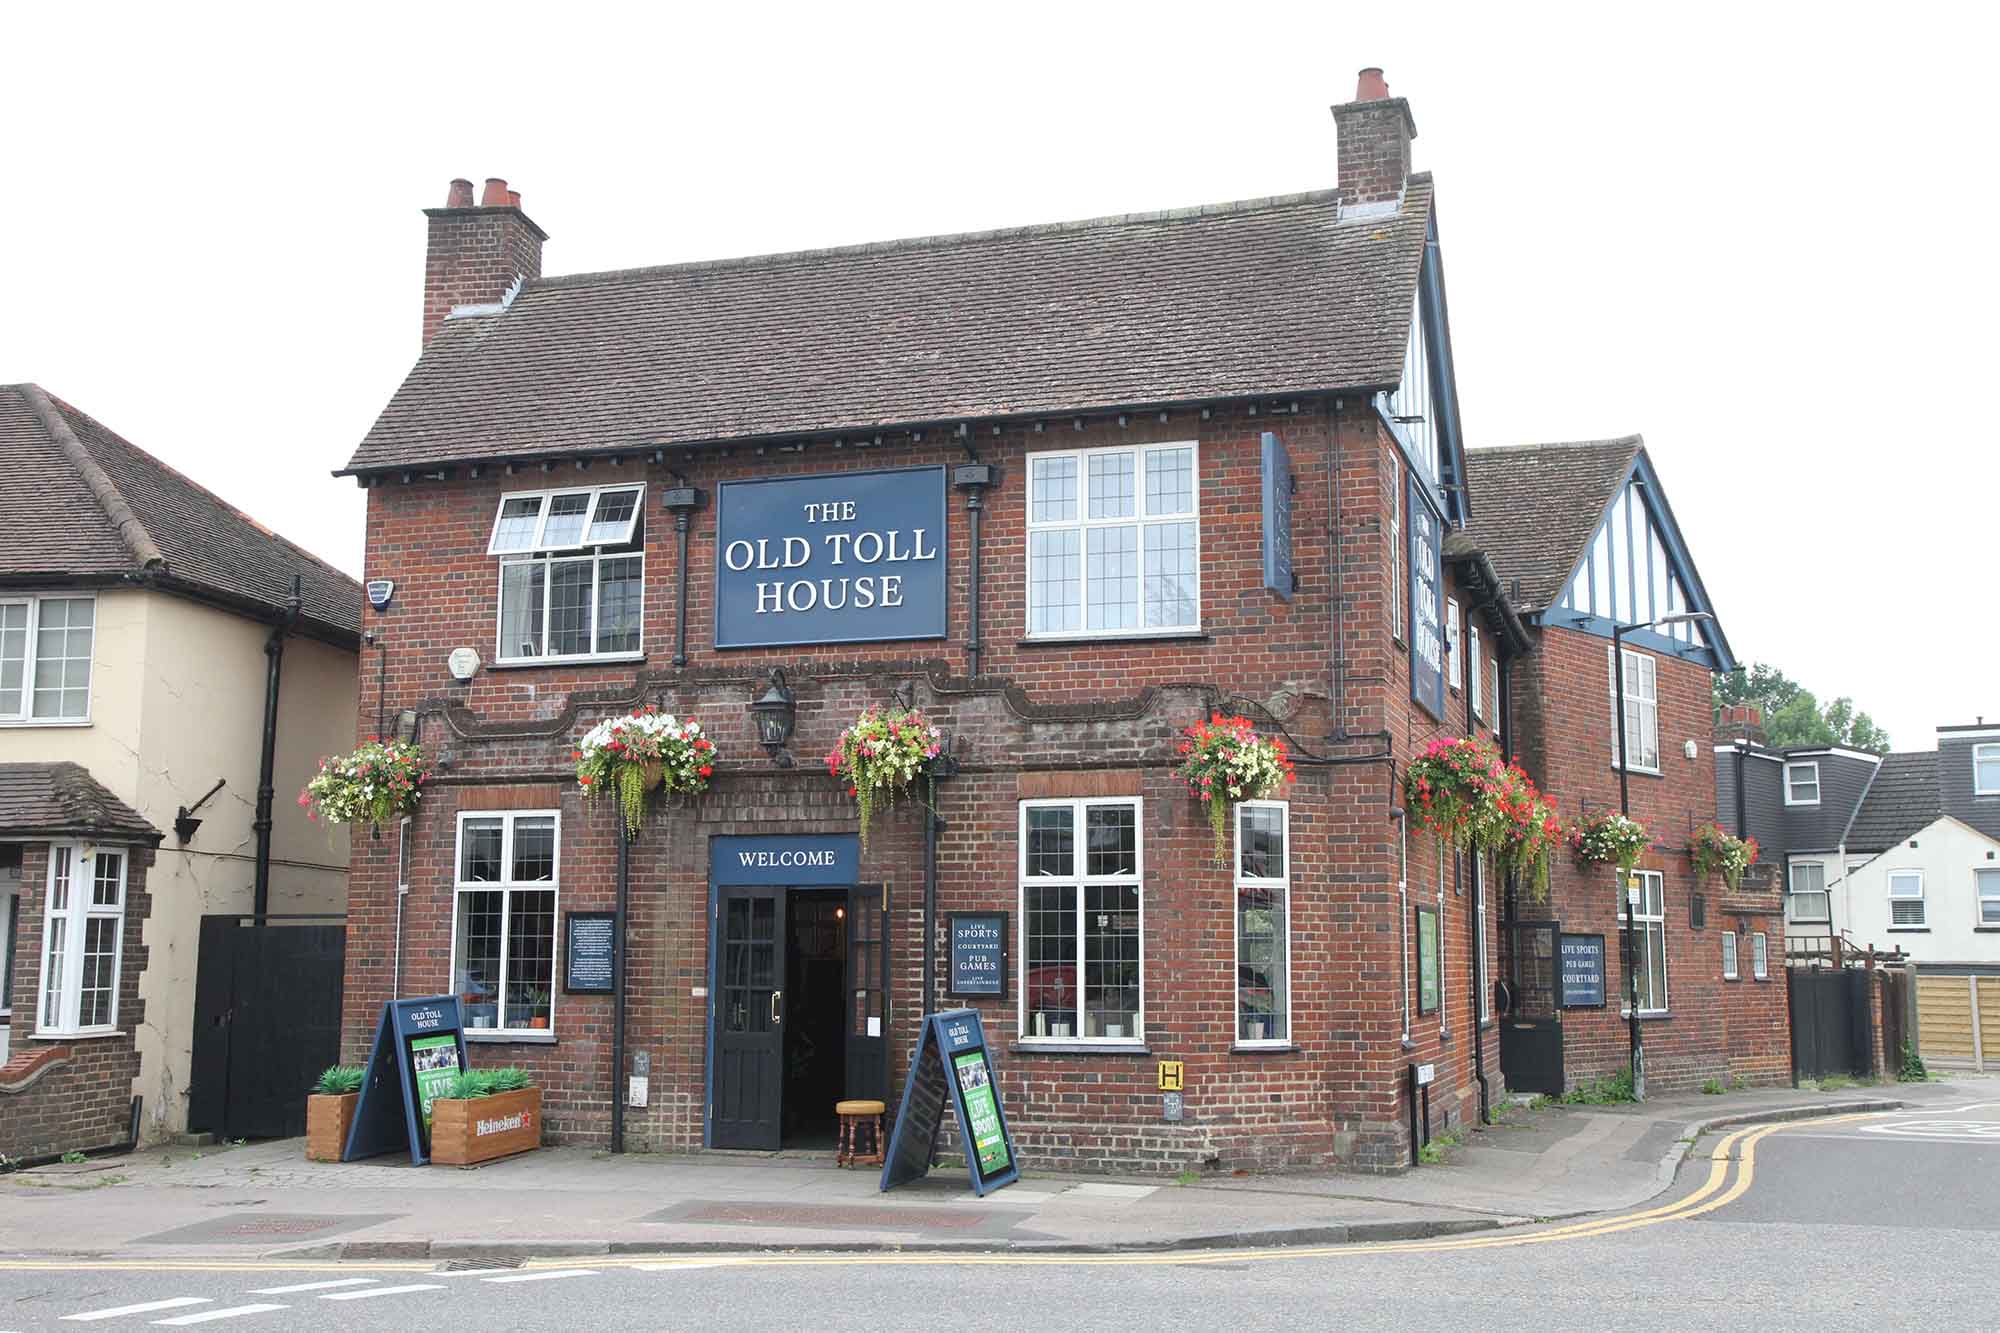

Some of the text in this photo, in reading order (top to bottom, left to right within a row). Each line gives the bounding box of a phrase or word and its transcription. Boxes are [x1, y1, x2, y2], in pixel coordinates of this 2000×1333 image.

[804, 501, 857, 523] THE
[725, 528, 937, 571] OLD TOLL
[755, 575, 904, 613] HOUSE
[738, 850, 835, 867] WELCOME
[957, 929, 999, 938] SPORTS
[1561, 944, 1599, 954] LIVE SPORTS
[960, 962, 997, 971] GAMES
[1566, 960, 1595, 968] PUB GAMES
[1562, 974, 1600, 984] COURTYARD
[411, 1010, 443, 1021] OLD TOLL
[417, 1019, 439, 1029] HOUSE
[1162, 1063, 1179, 1087] H
[476, 1112, 522, 1137] Heineken
